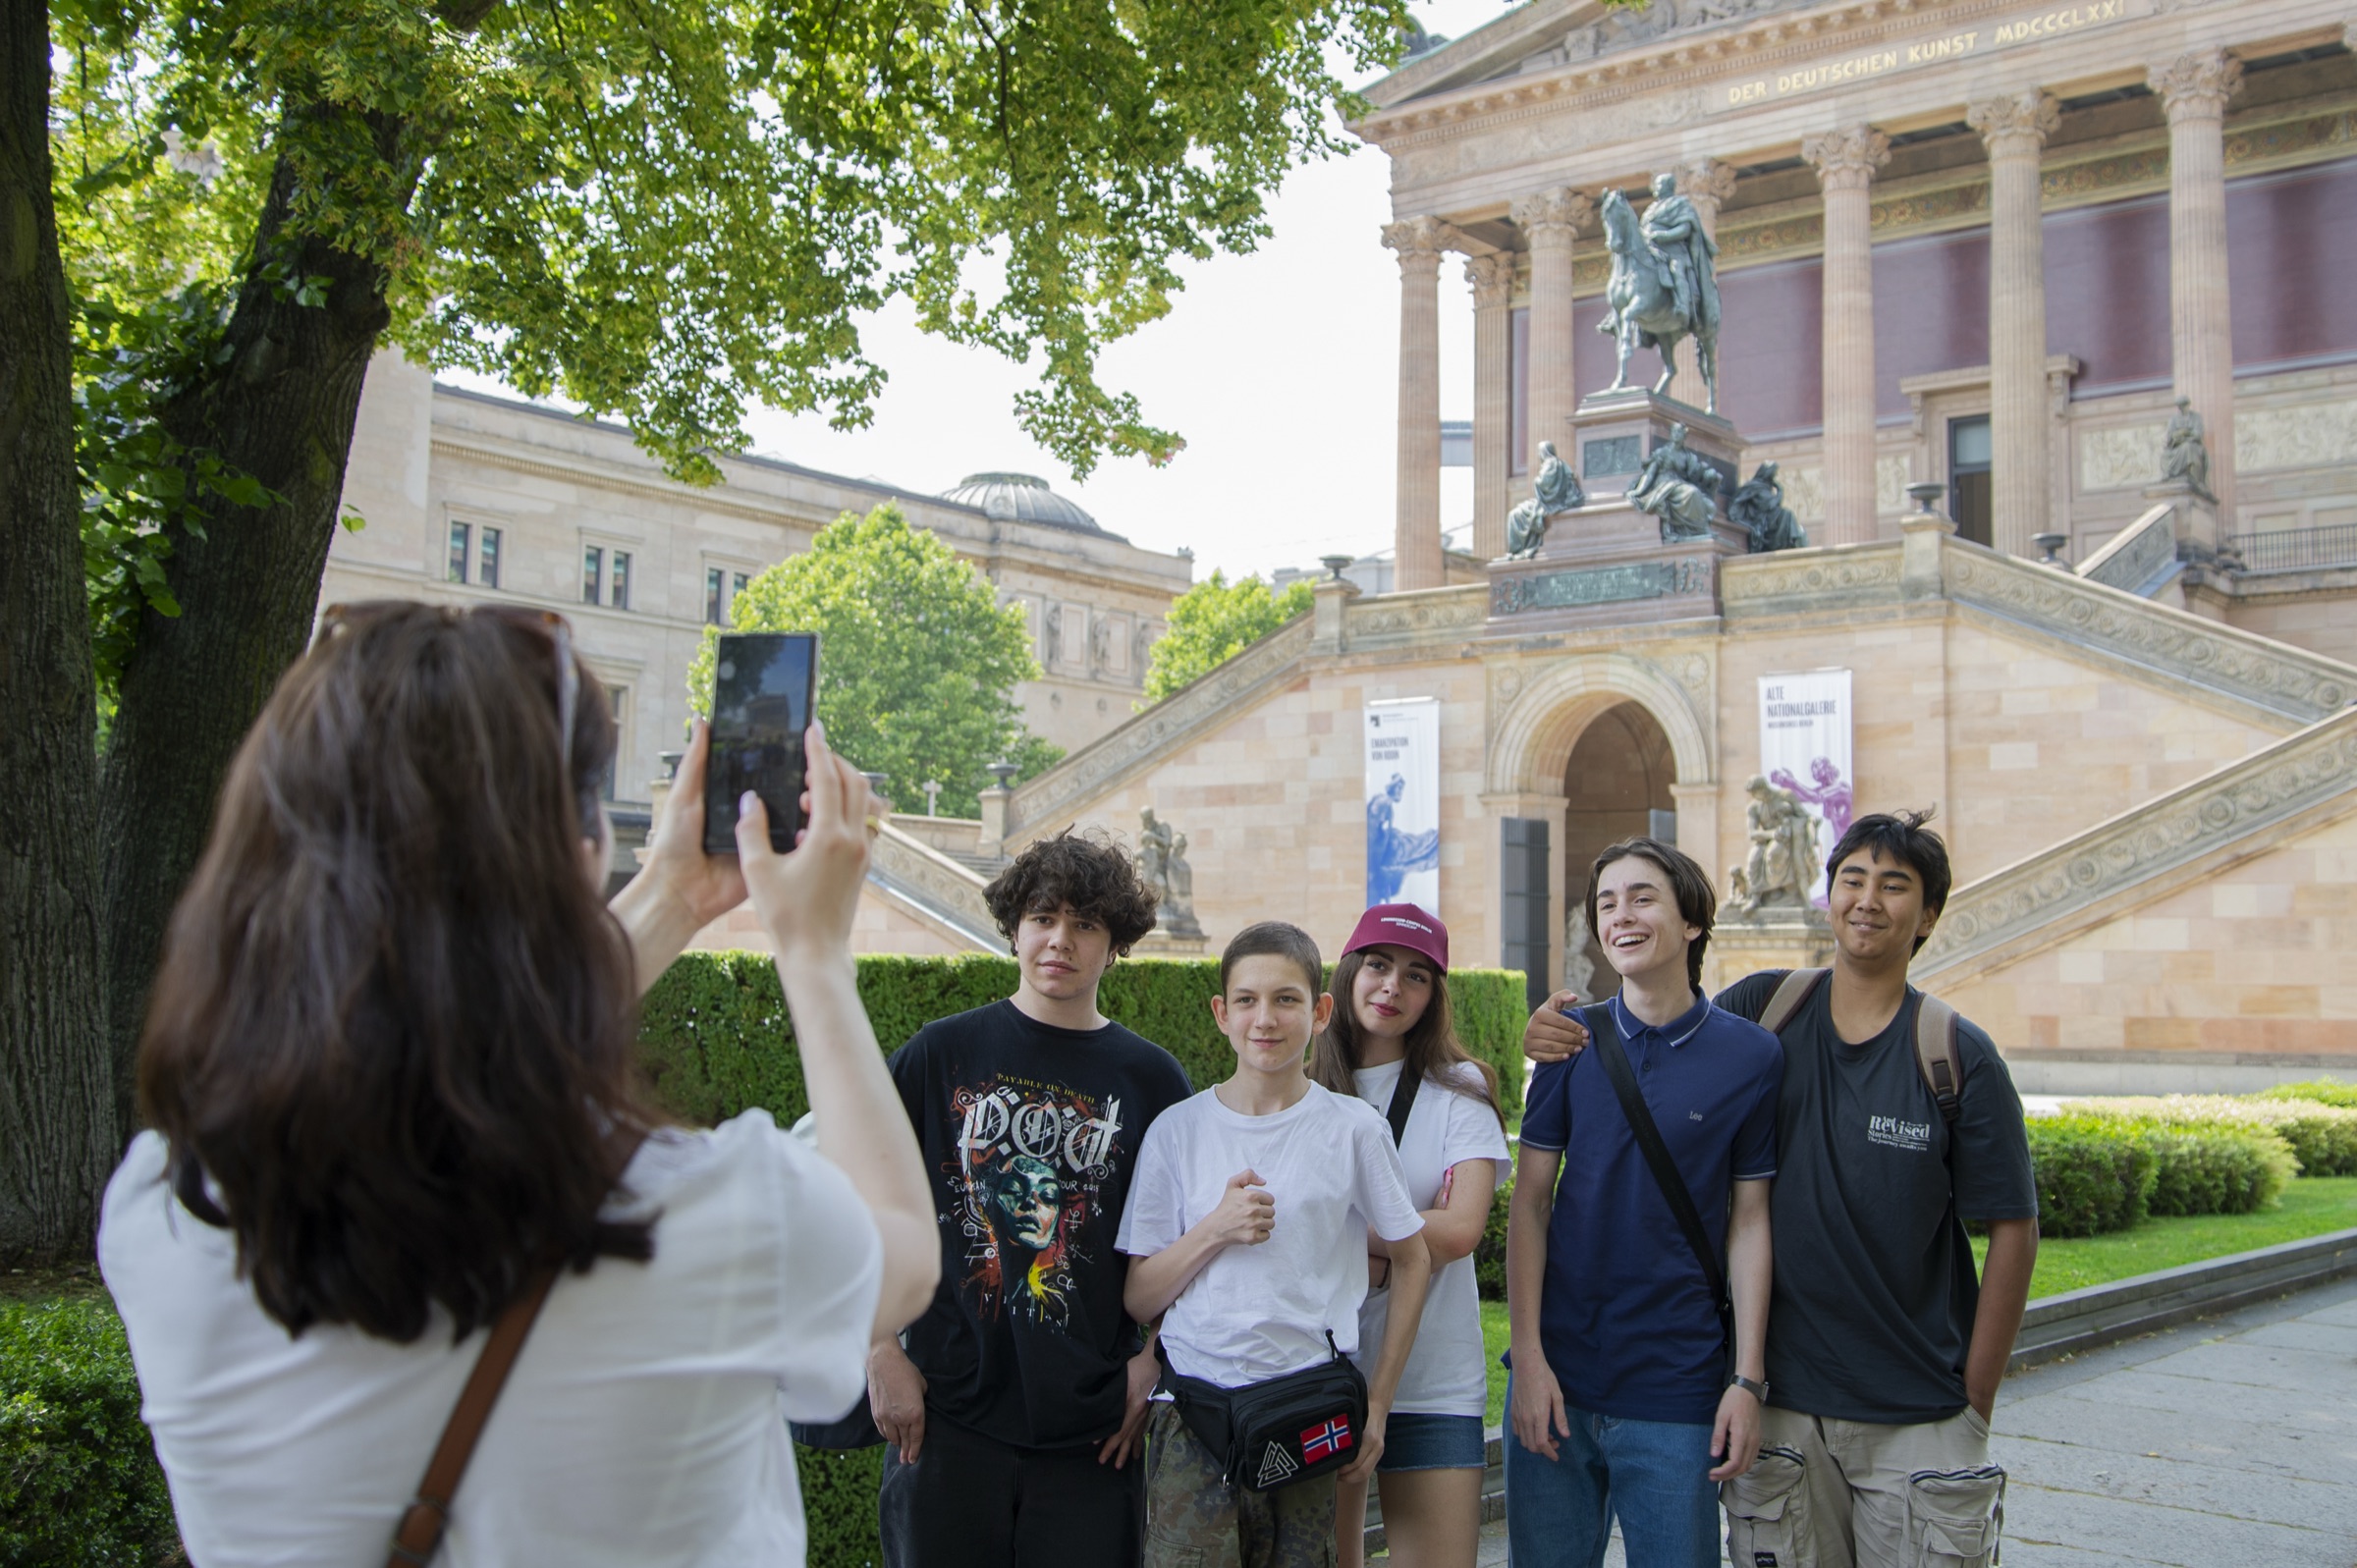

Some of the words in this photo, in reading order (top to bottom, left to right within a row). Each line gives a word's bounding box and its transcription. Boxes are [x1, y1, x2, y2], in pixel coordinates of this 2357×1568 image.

[1729, 81, 1767, 104] DER
[1778, 50, 1897, 93] DEUTSCHEN
[1907, 31, 1978, 63] KUNST
[1995, 0, 2124, 44] MDCCCLXXI
[1767, 686, 1784, 701] ALTE
[1768, 700, 1836, 718] NATIONALGALERIE
[996, 1072, 1043, 1089] PAYABLE
[1046, 1084, 1061, 1093] ON
[1064, 1088, 1095, 1104] DEATH
[1689, 1110, 1703, 1121] Lee
[1868, 1129, 1892, 1139] Stories
[1869, 1115, 1930, 1138] Revised
[1059, 1179, 1079, 1193] OUR
